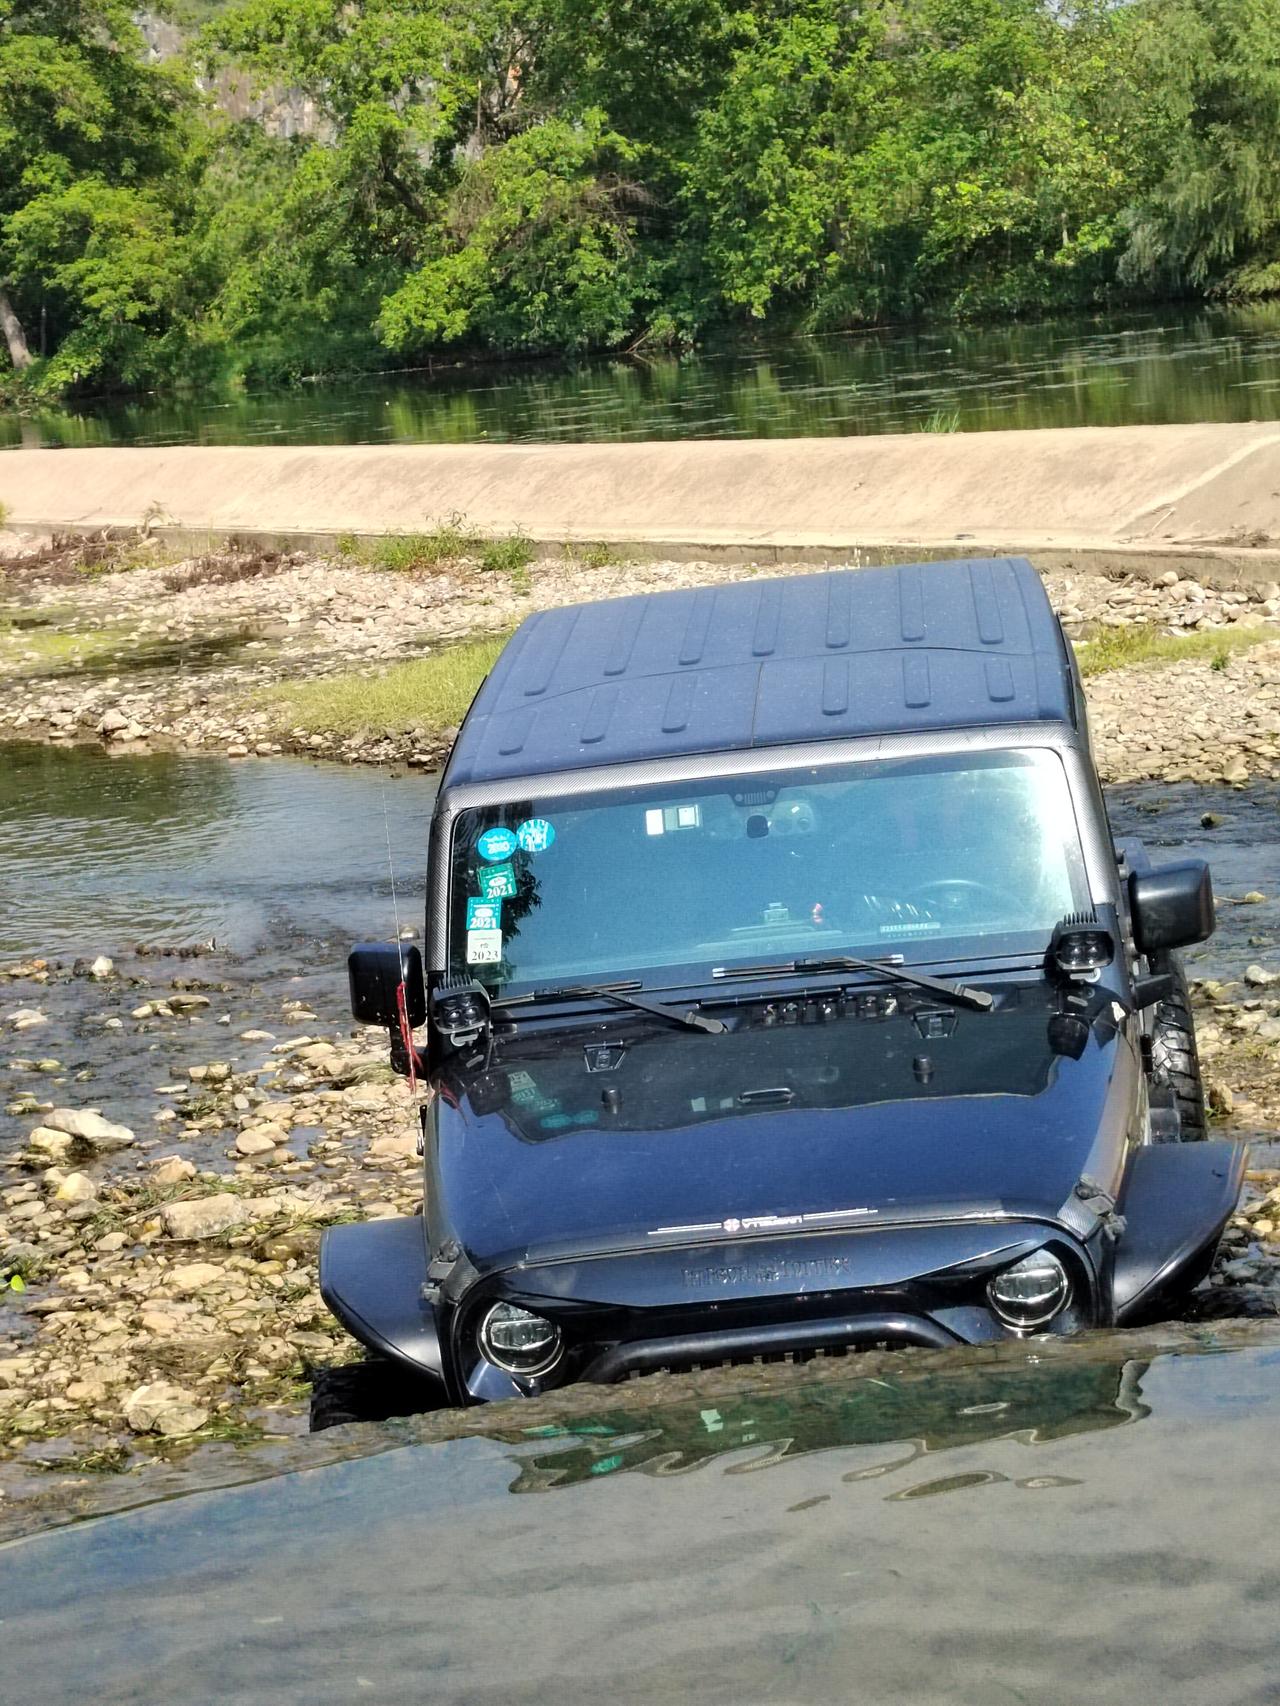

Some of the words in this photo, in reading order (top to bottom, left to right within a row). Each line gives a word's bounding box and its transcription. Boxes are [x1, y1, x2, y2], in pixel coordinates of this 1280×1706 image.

[486, 883, 513, 899] 2021
[469, 917, 497, 929] 2021
[472, 950, 499, 961] 2023
